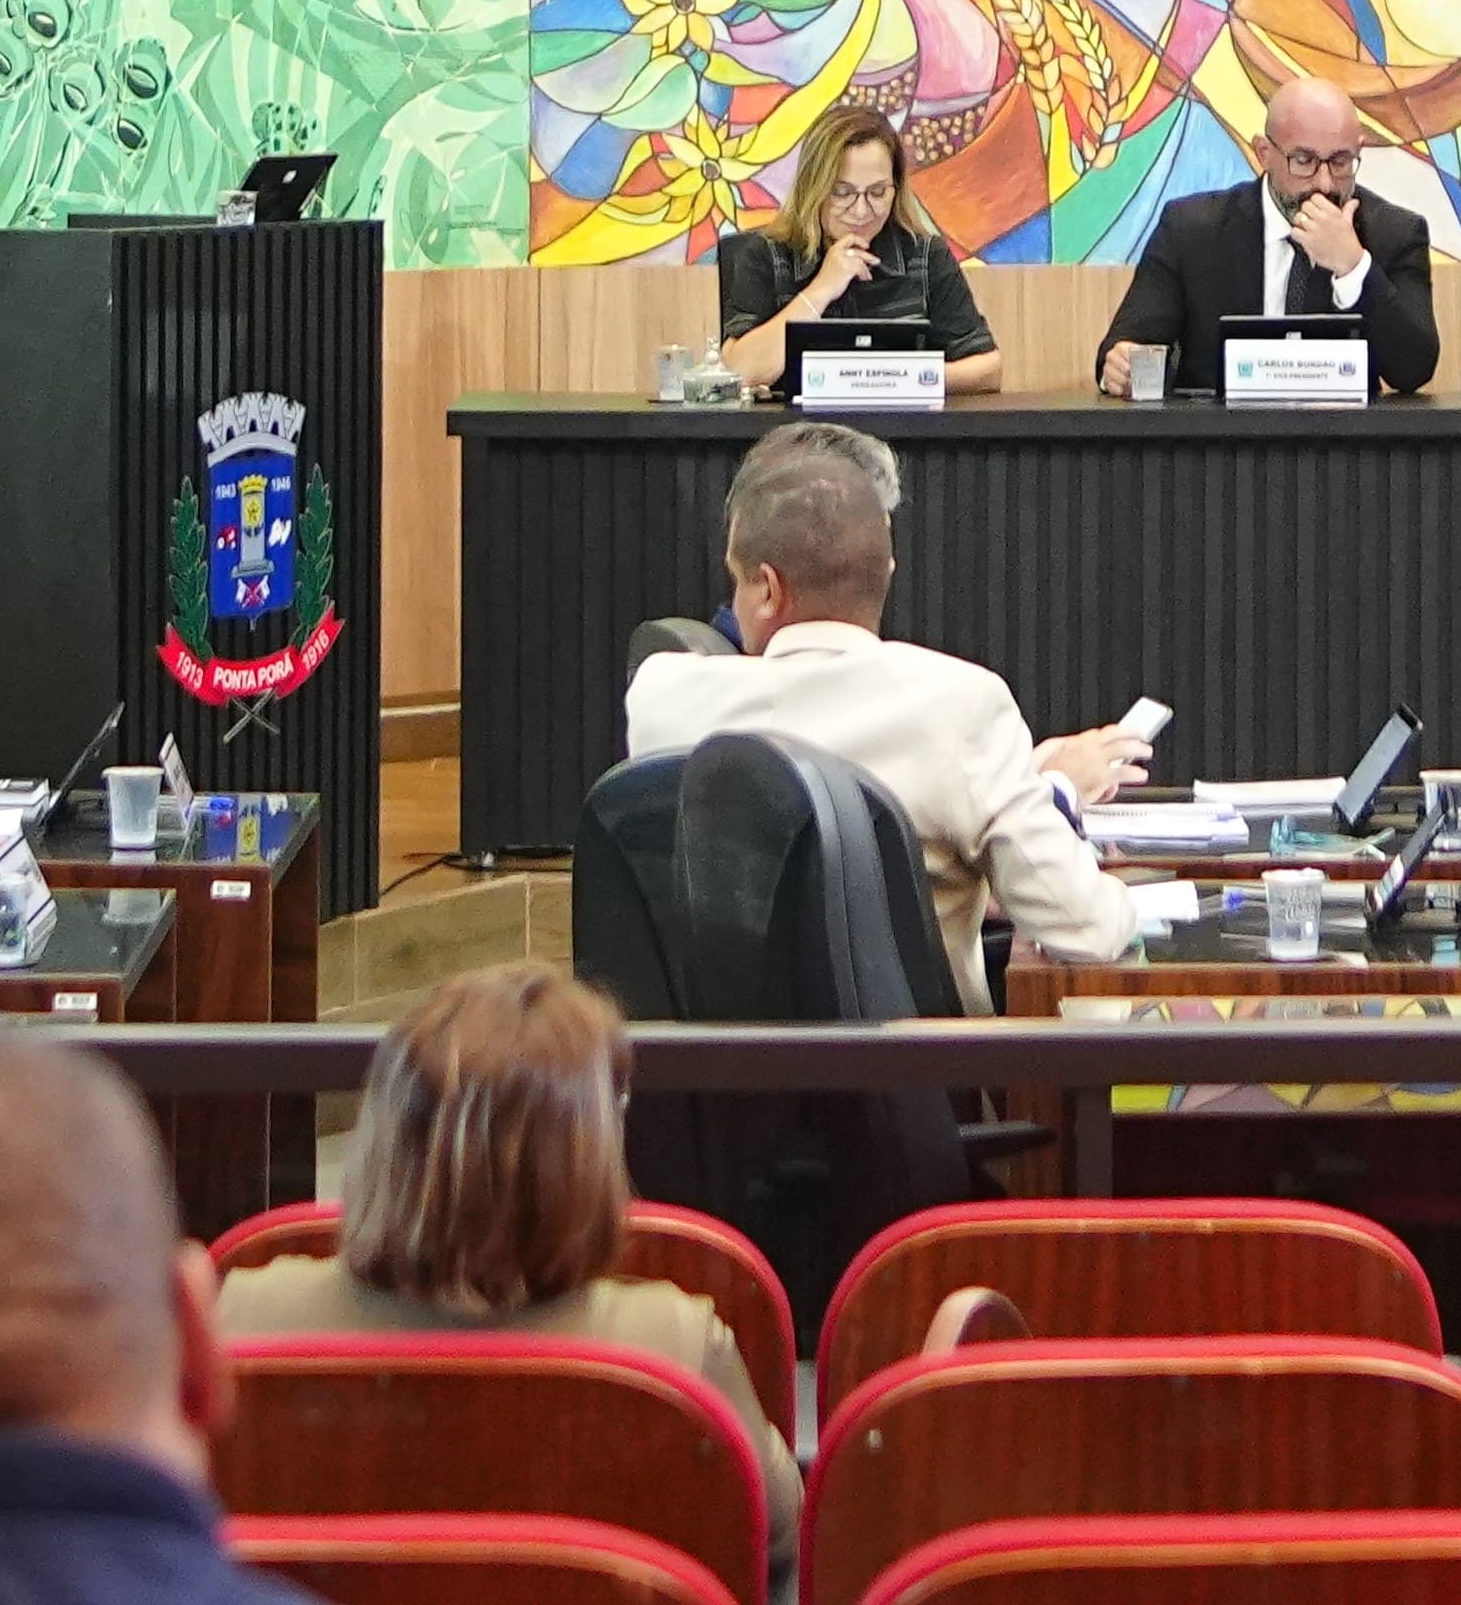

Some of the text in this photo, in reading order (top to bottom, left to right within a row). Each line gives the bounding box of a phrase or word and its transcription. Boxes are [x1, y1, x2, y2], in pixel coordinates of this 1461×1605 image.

[1258, 359, 1294, 368] CARLOS
[176, 629, 330, 691] 1913 PONTA PORÃ 1916
